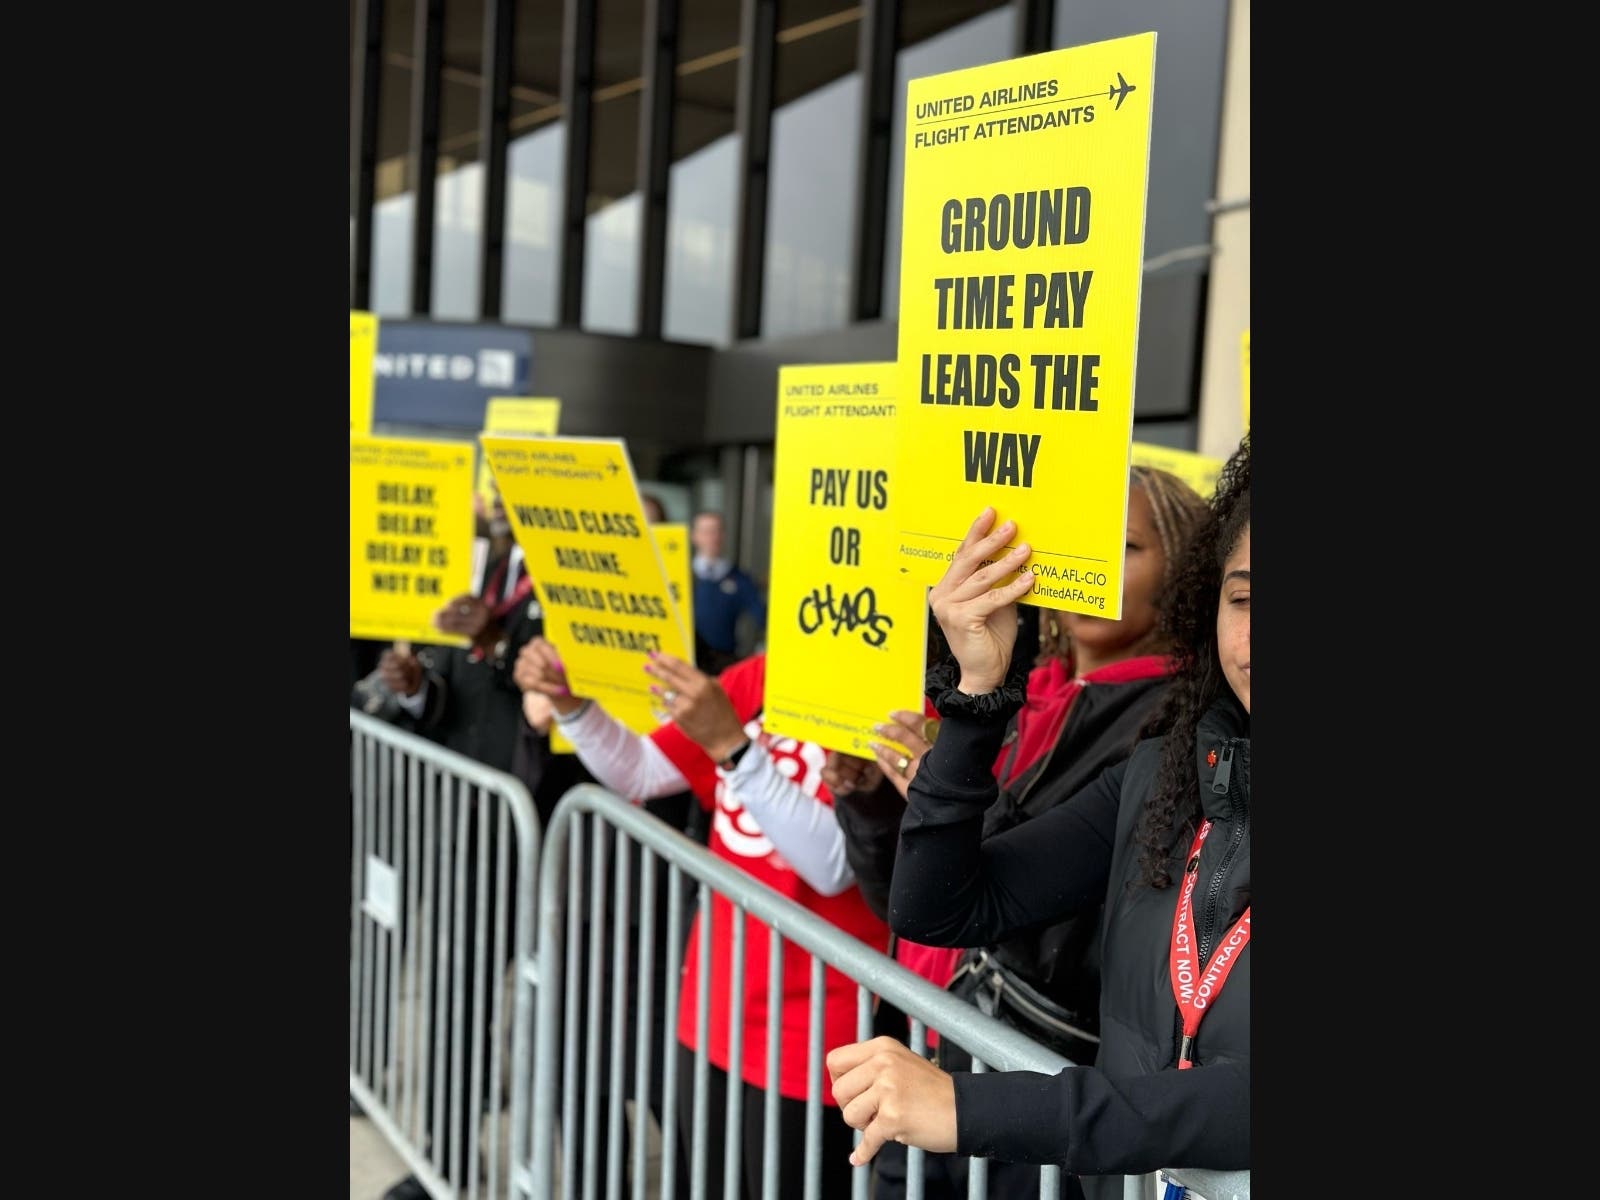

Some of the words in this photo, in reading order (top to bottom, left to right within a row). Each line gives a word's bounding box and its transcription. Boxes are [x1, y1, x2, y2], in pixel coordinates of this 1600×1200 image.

[915, 95, 975, 119] UNITED
[979, 79, 1059, 108] AIRLINES
[914, 125, 970, 148] FLIGHT
[973, 105, 1095, 139] ATTENDANTS
[940, 186, 1092, 254] GROUND
[934, 275, 1016, 330] TIME
[1023, 271, 1094, 329] PAY
[373, 353, 475, 381] NITED
[920, 353, 1021, 409] LEADS
[1030, 354, 1101, 412] THE
[786, 384, 824, 396] UNITED
[828, 383, 879, 396] AIRLINES
[785, 405, 820, 417] FLIGHT
[824, 404, 896, 417] ATTENDANT
[963, 430, 1042, 488] WAY
[810, 468, 851, 507] PAY
[856, 469, 889, 511] US
[512, 503, 578, 532] WORLD
[579, 509, 641, 539] CLASS
[366, 542, 422, 566] DELAY
[427, 546, 448, 568] IS
[830, 525, 861, 567] OR
[899, 544, 944, 561] Association
[372, 572, 409, 595] NOT
[415, 576, 442, 597] OK
[541, 582, 605, 610] WORLD
[606, 589, 667, 619] CLASS
[1033, 583, 1105, 609] UnitedAFA.org
[798, 583, 893, 646] CHAOS
[570, 621, 660, 653] CONTRACT
[1176, 871, 1198, 955] CONTRACT
[1176, 959, 1194, 1004] NOW!
[1193, 926, 1247, 1009] CONTRACT
